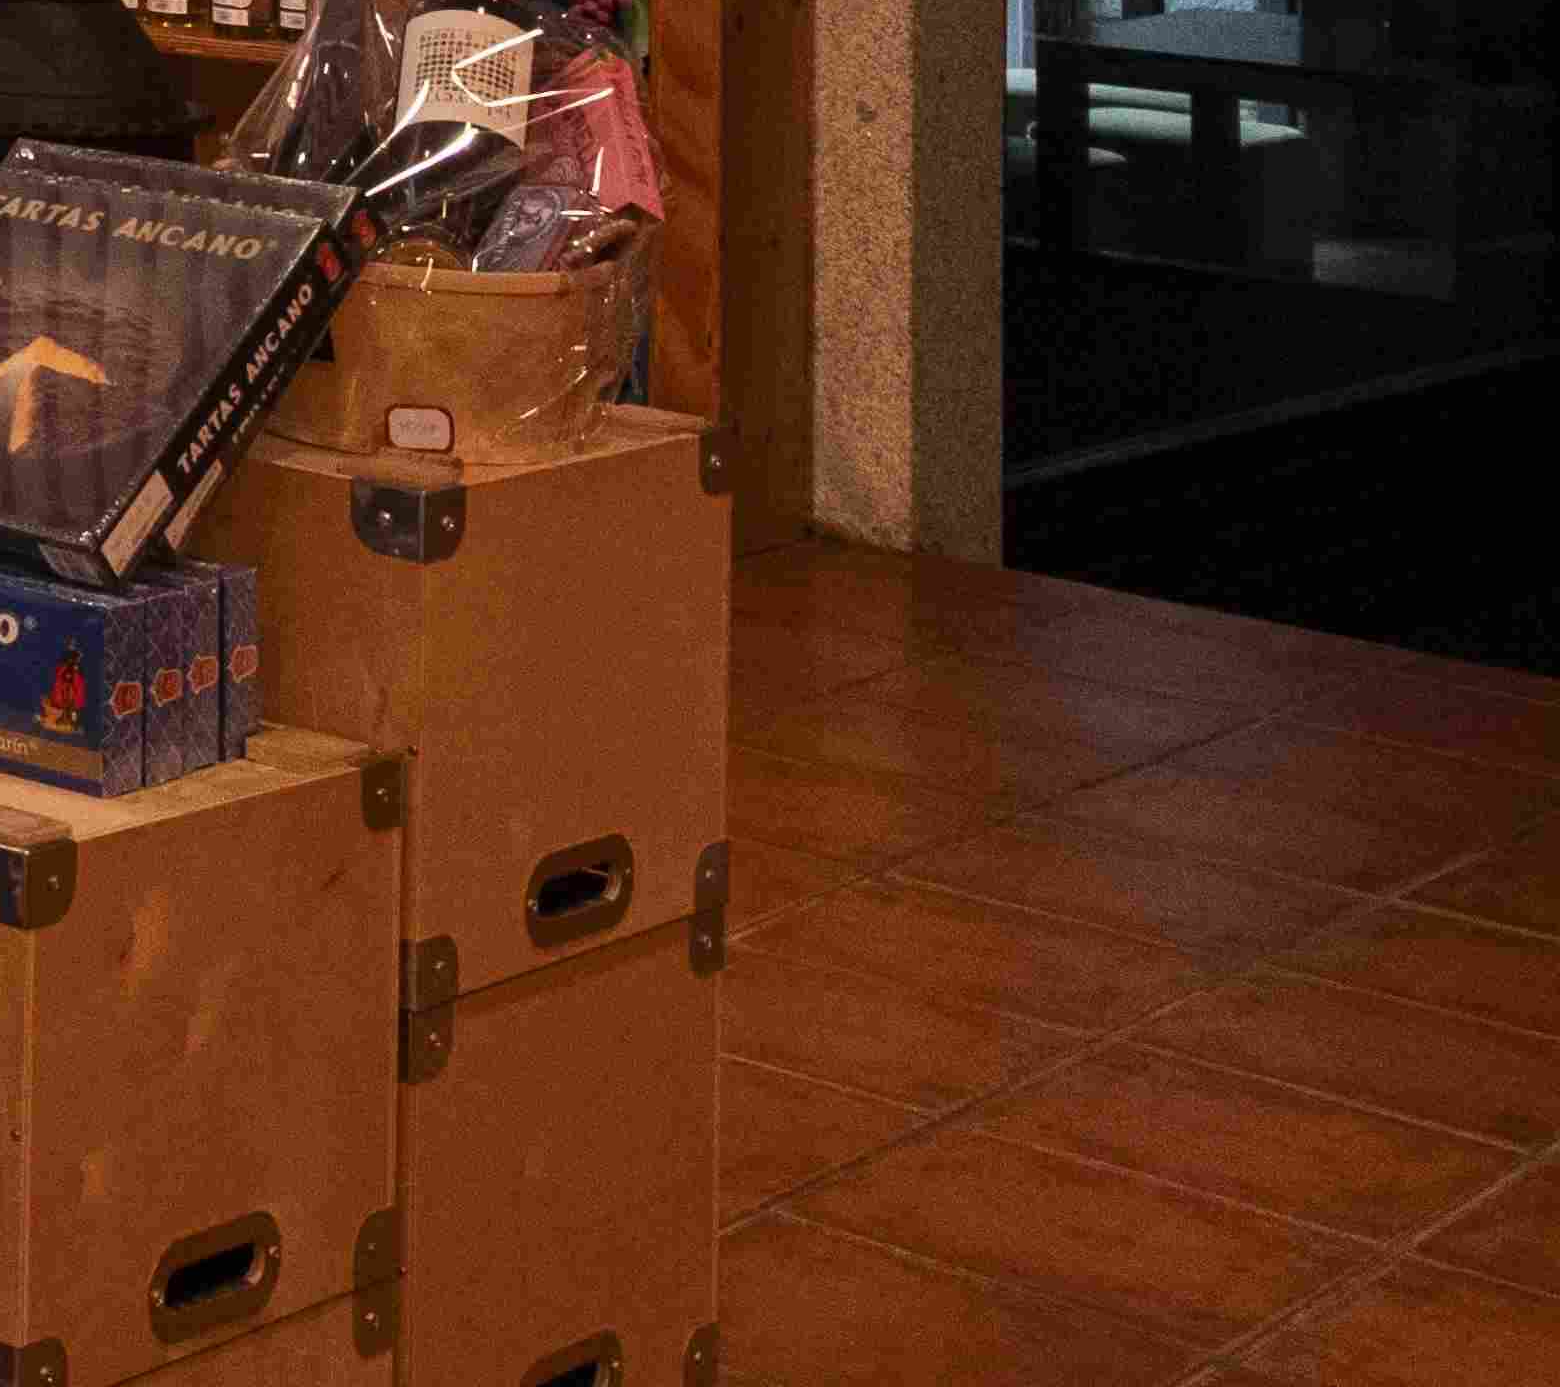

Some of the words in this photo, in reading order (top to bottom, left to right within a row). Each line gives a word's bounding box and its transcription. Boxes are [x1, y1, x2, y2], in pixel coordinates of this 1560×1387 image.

[119, 217, 266, 261] ANCANO
[177, 383, 243, 475] TARTAS
[245, 282, 314, 380] ANCANO
